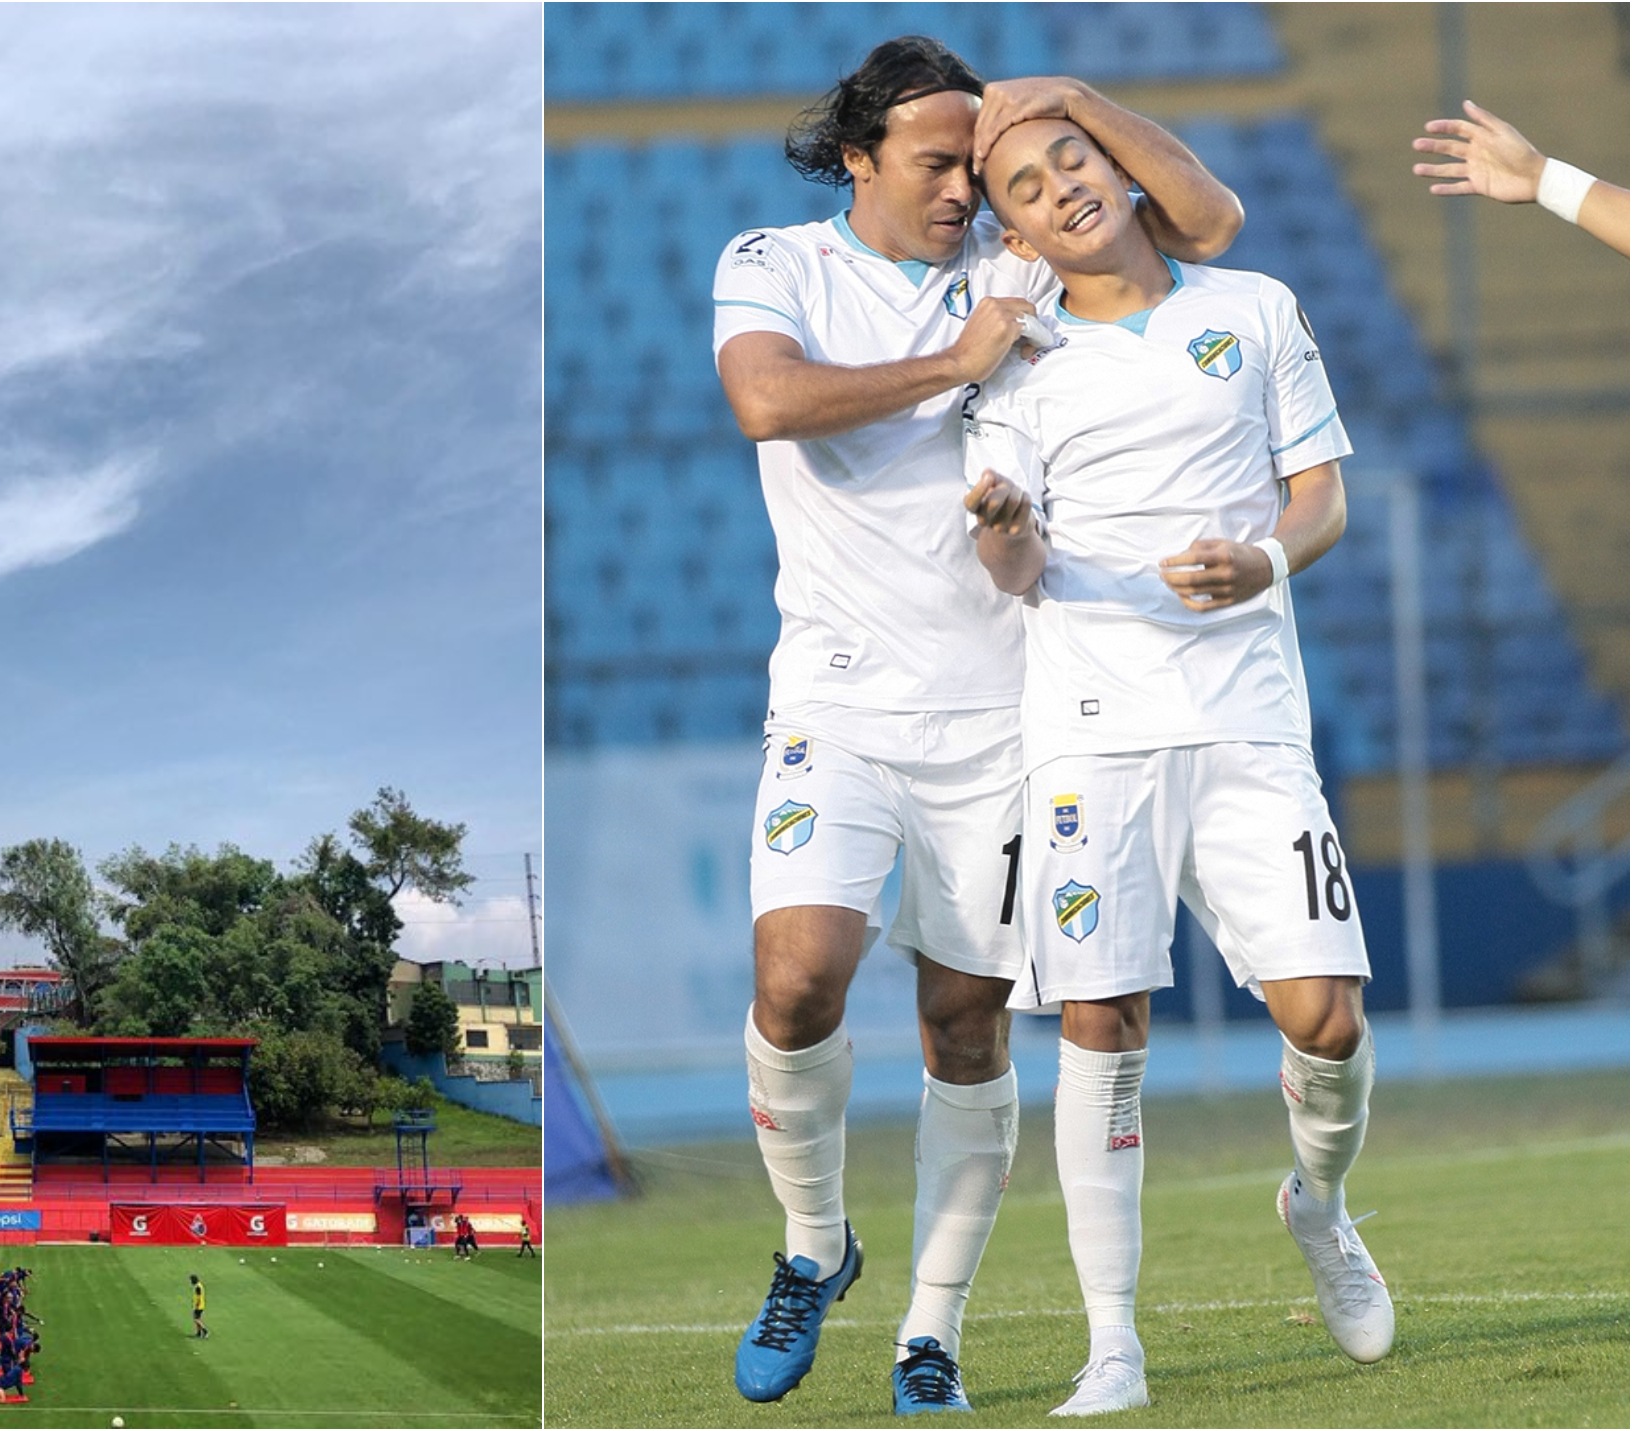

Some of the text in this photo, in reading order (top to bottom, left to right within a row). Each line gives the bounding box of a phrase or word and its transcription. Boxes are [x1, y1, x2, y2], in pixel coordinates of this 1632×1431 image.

[1293, 830, 1351, 922] 18
[133, 1215, 147, 1231] G
[250, 1215, 265, 1231] G
